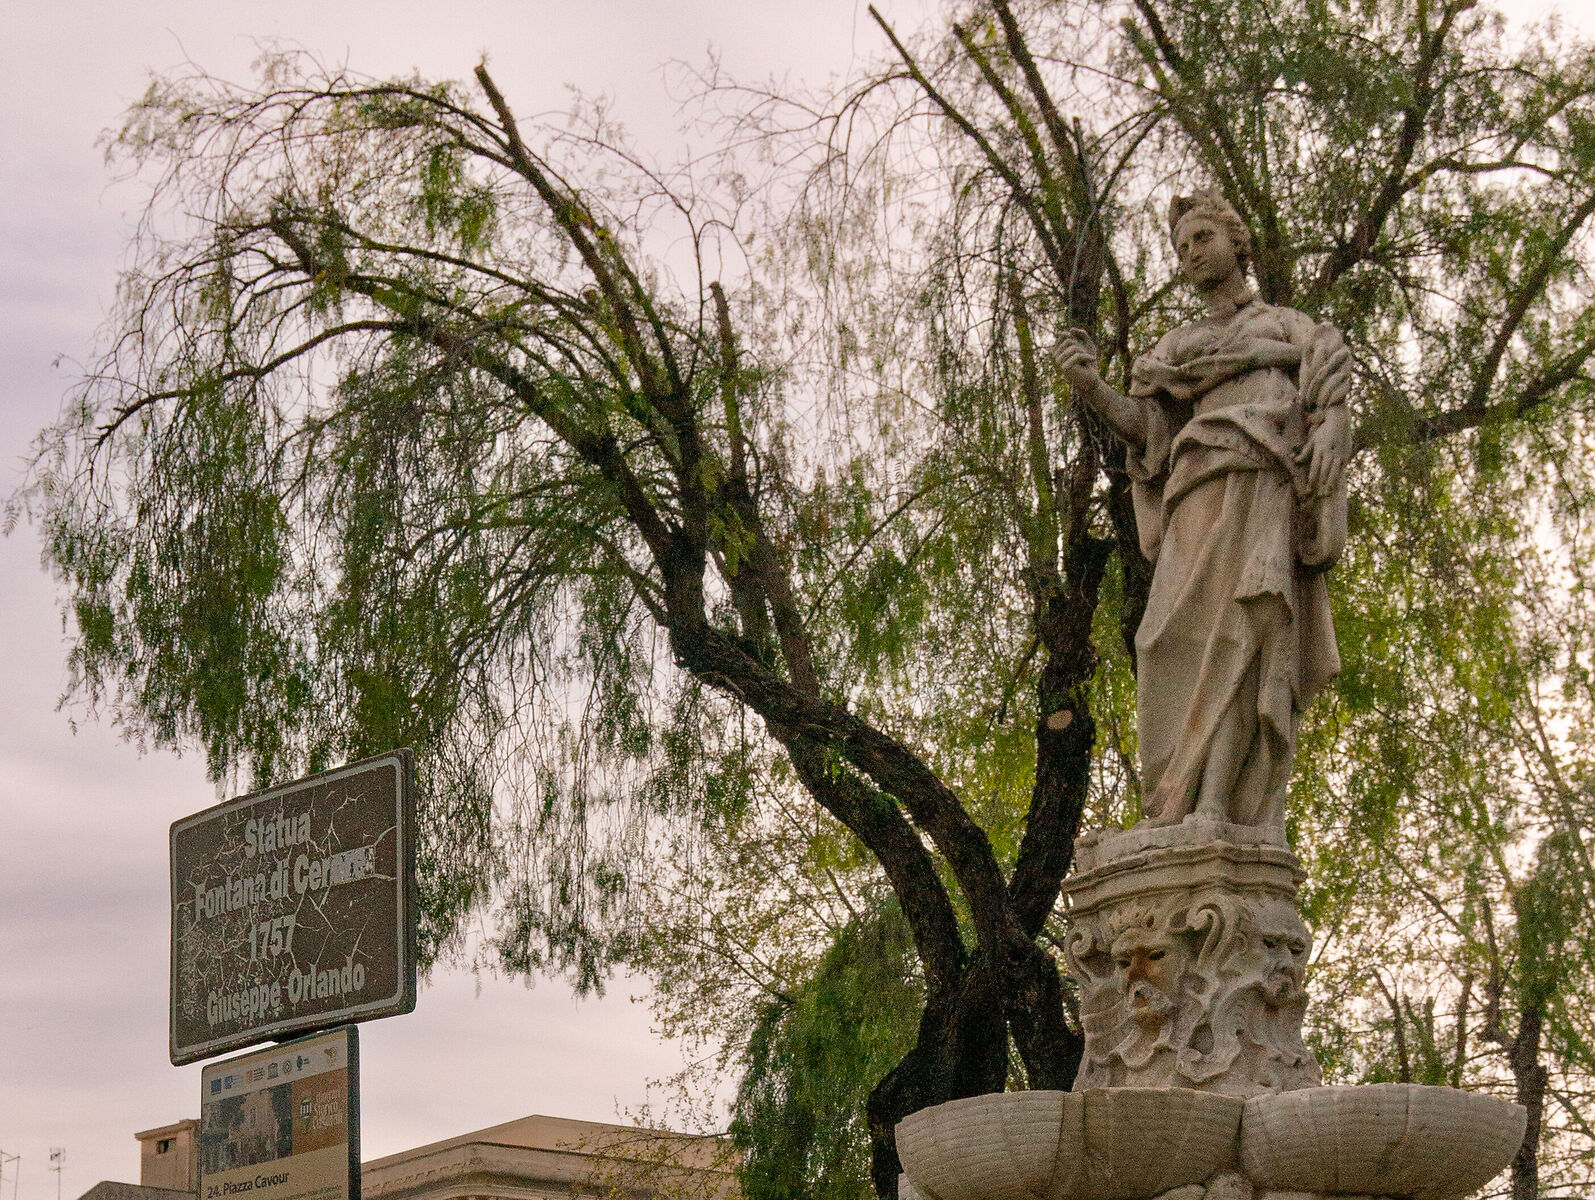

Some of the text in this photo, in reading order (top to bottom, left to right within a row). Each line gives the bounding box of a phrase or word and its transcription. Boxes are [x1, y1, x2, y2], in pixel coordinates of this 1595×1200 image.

[245, 812, 311, 857] Statua
[270, 859, 289, 898] di
[250, 914, 296, 962] 1757
[207, 962, 365, 1026] Giuseppe Orlando
[207, 1172, 290, 1198] 24. Piazza Cavour
